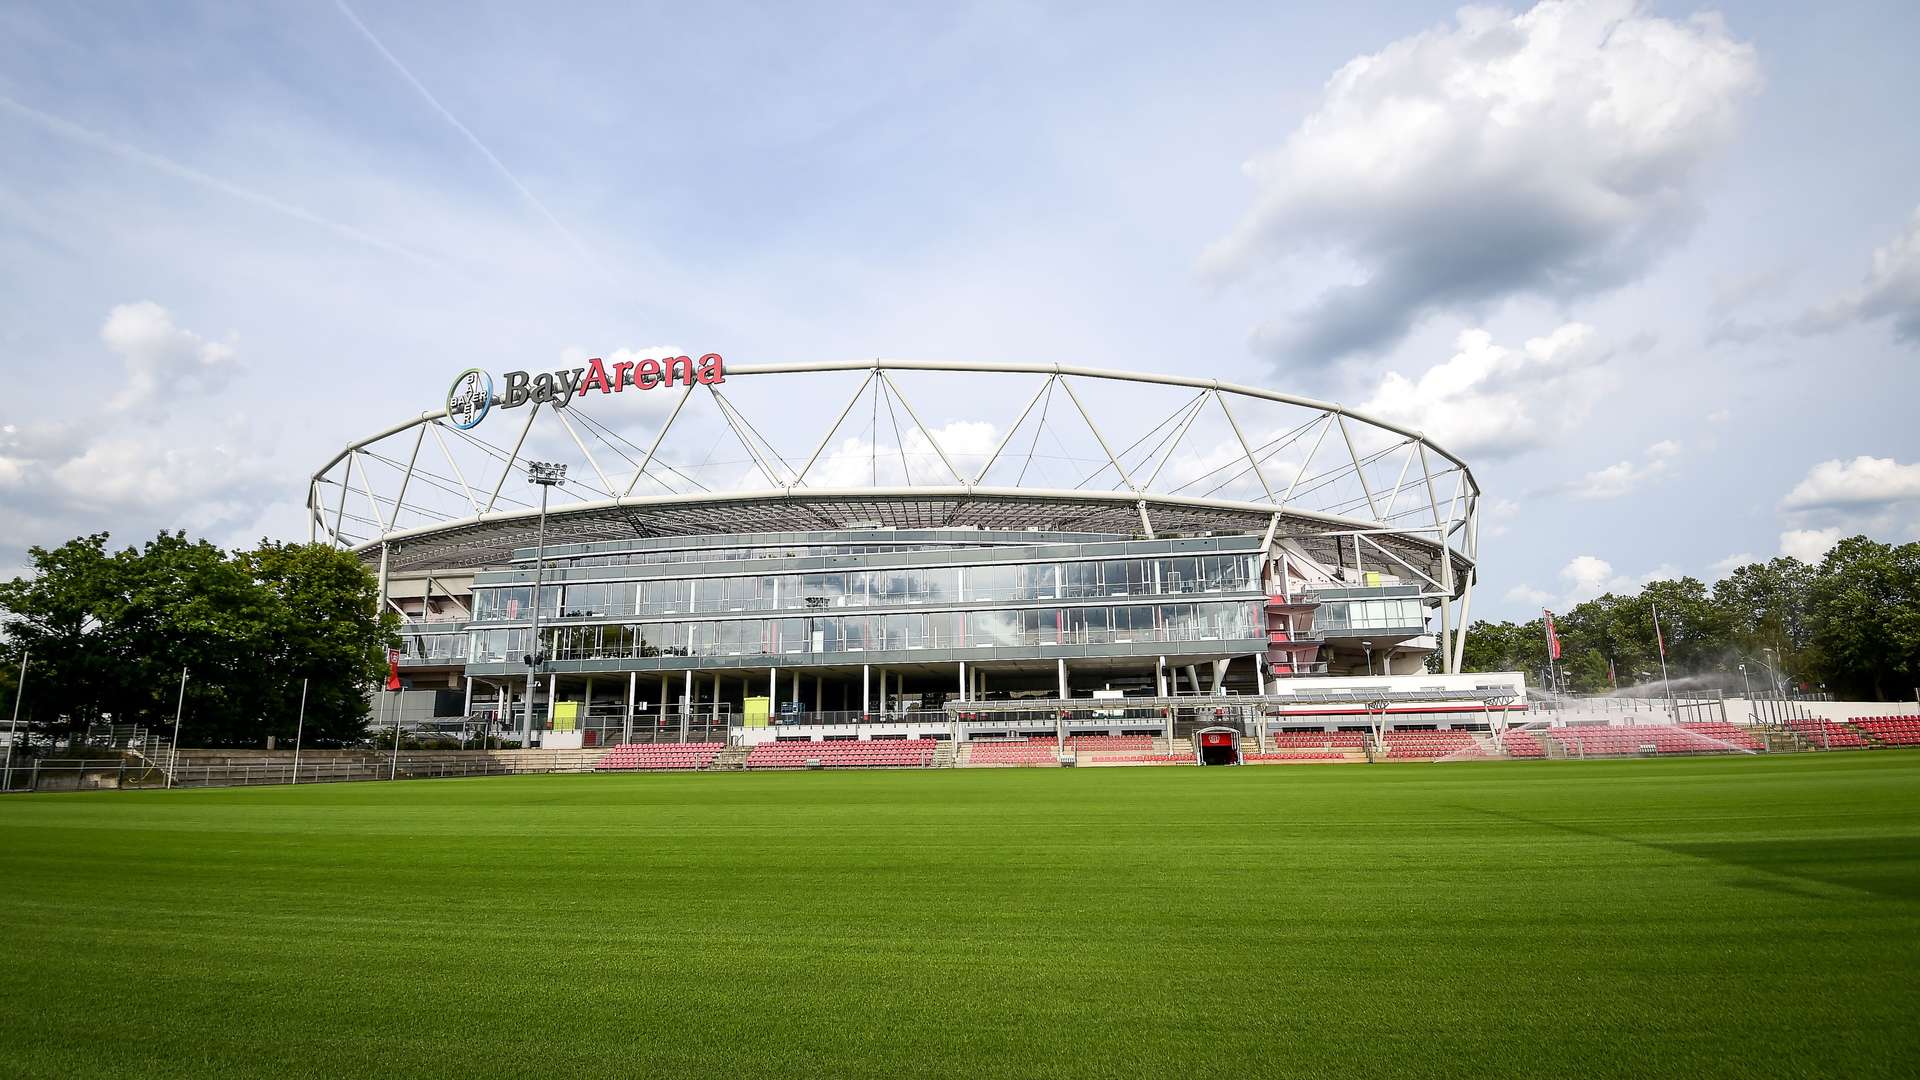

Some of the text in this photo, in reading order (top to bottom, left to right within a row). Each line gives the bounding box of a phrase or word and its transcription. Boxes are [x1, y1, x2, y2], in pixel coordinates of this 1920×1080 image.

[450, 390, 487, 409] BAYER
[464, 374, 475, 424] BAYER
[501, 352, 725, 409] BayArena
